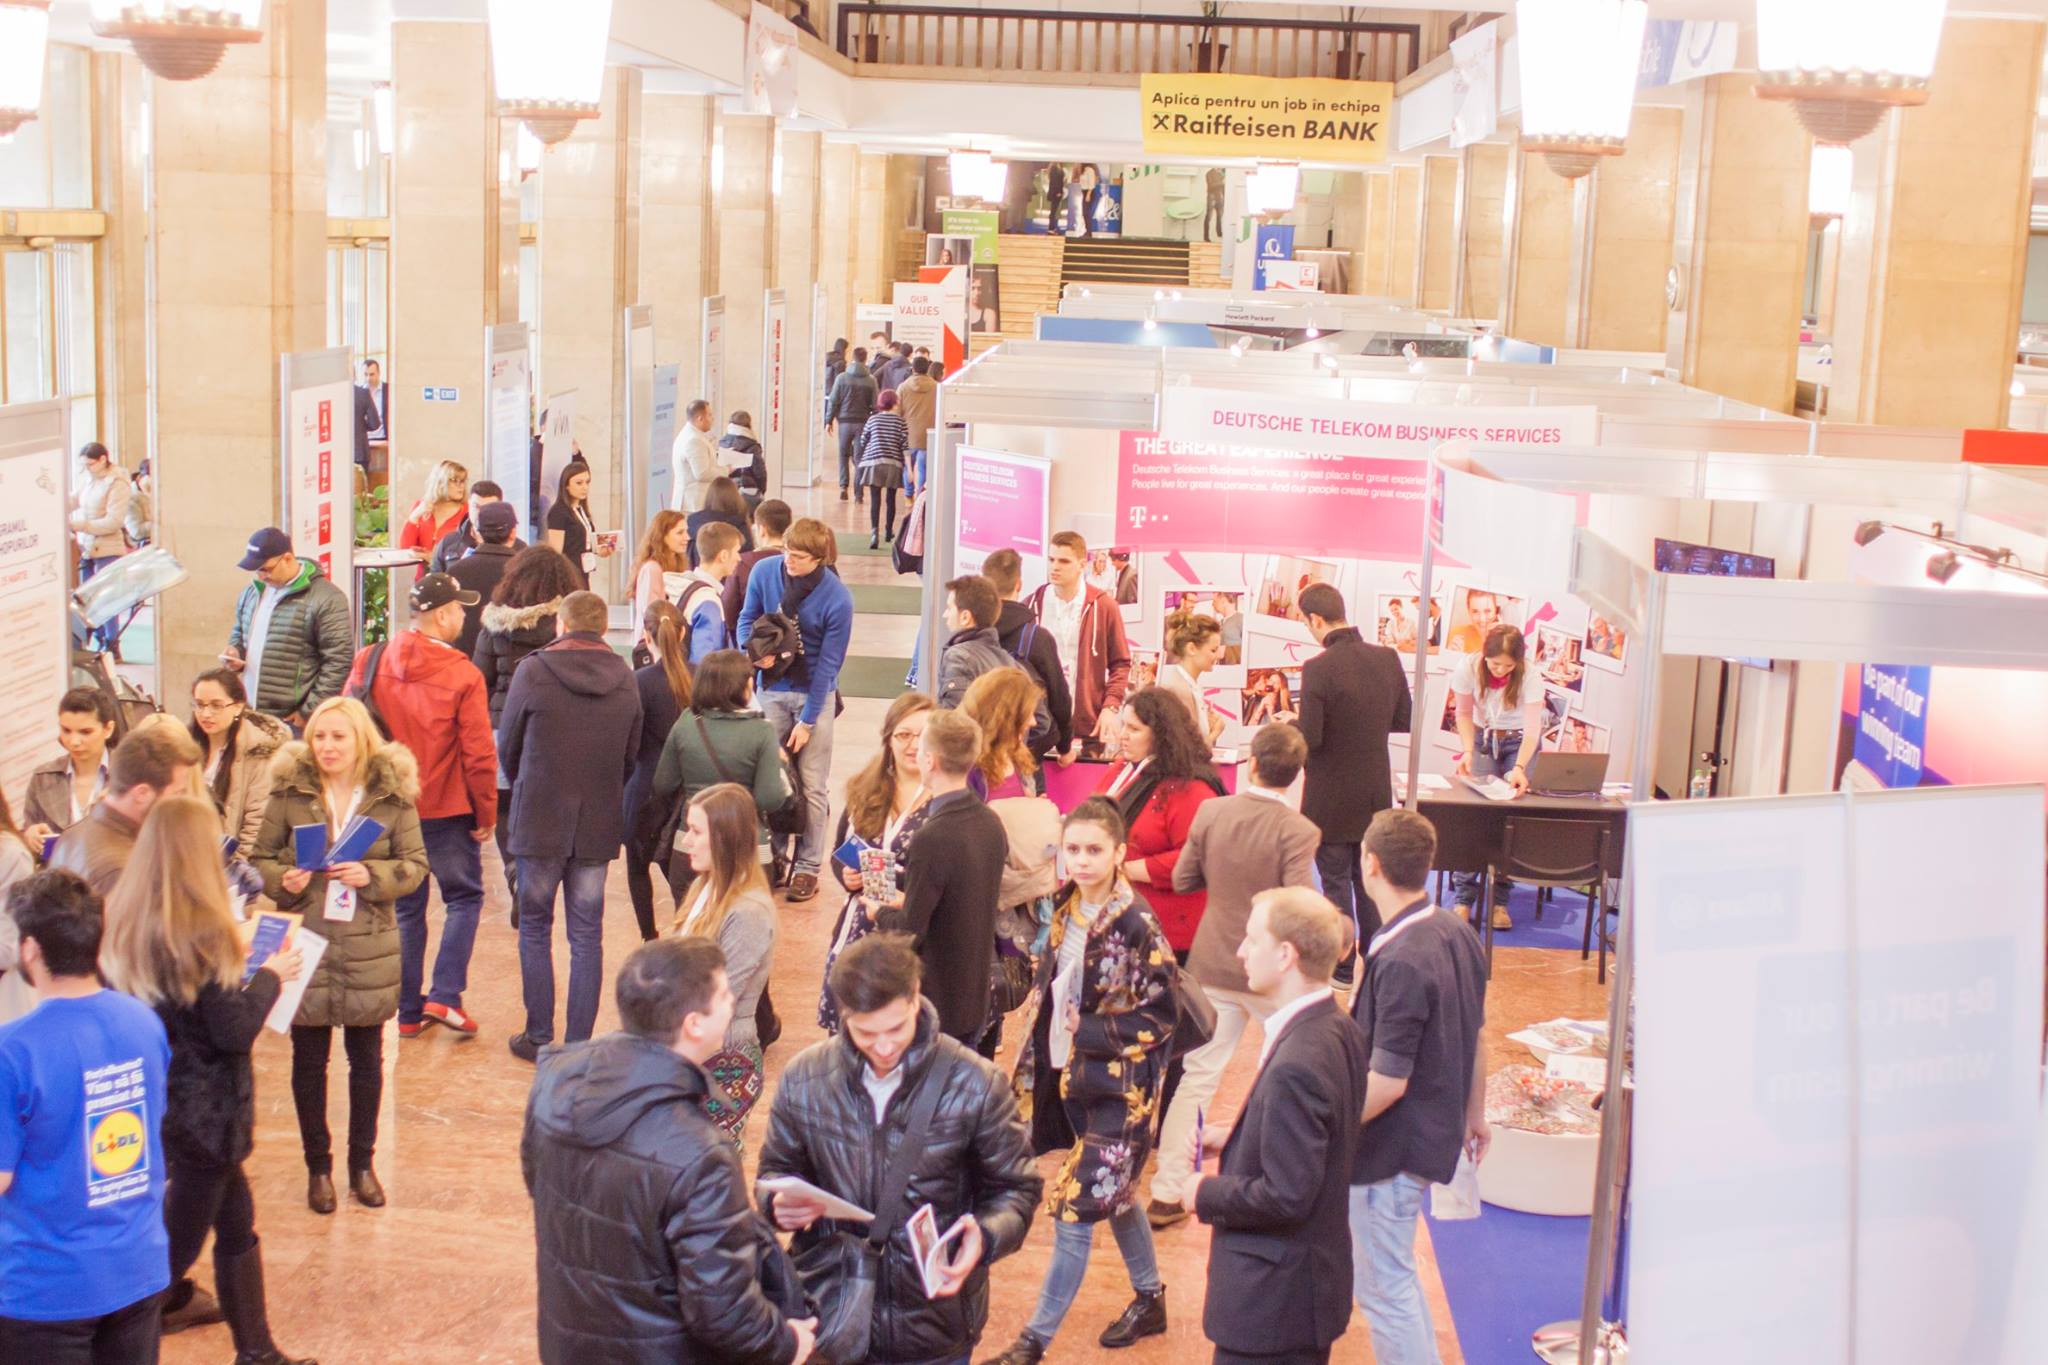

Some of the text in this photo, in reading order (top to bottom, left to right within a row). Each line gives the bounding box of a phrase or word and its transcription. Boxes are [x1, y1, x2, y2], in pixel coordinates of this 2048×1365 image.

[1205, 96, 1256, 114] pentru
[1261, 99, 1279, 110] un
[1284, 97, 1307, 114] job
[1331, 99, 1381, 116] echipa
[1173, 114, 1379, 142] Raiffeisen BANK
[910, 295, 929, 304] OUR
[899, 305, 940, 316] VALUES
[1225, 313, 1276, 323] Hewlett Packard
[1213, 410, 1303, 432] DEUTSCHE
[1310, 418, 1392, 439] TELEKOM
[1484, 428, 1561, 443] SERVICES
[1134, 437, 1167, 456] THE
[1132, 463, 1171, 475] Deutsche
[1173, 464, 1208, 475] Telekom
[1301, 469, 1324, 481] great
[1325, 470, 1350, 482] place
[1352, 471, 1364, 481] for
[1366, 473, 1389, 485] great
[1131, 479, 1161, 491] People
[1176, 480, 1189, 490] for
[1190, 481, 1212, 492] great
[1307, 484, 1340, 497] people
[1341, 486, 1369, 497] create
[1371, 487, 1394, 500] great
[1904, 689, 1925, 718] our
[1893, 732, 1921, 771] team
